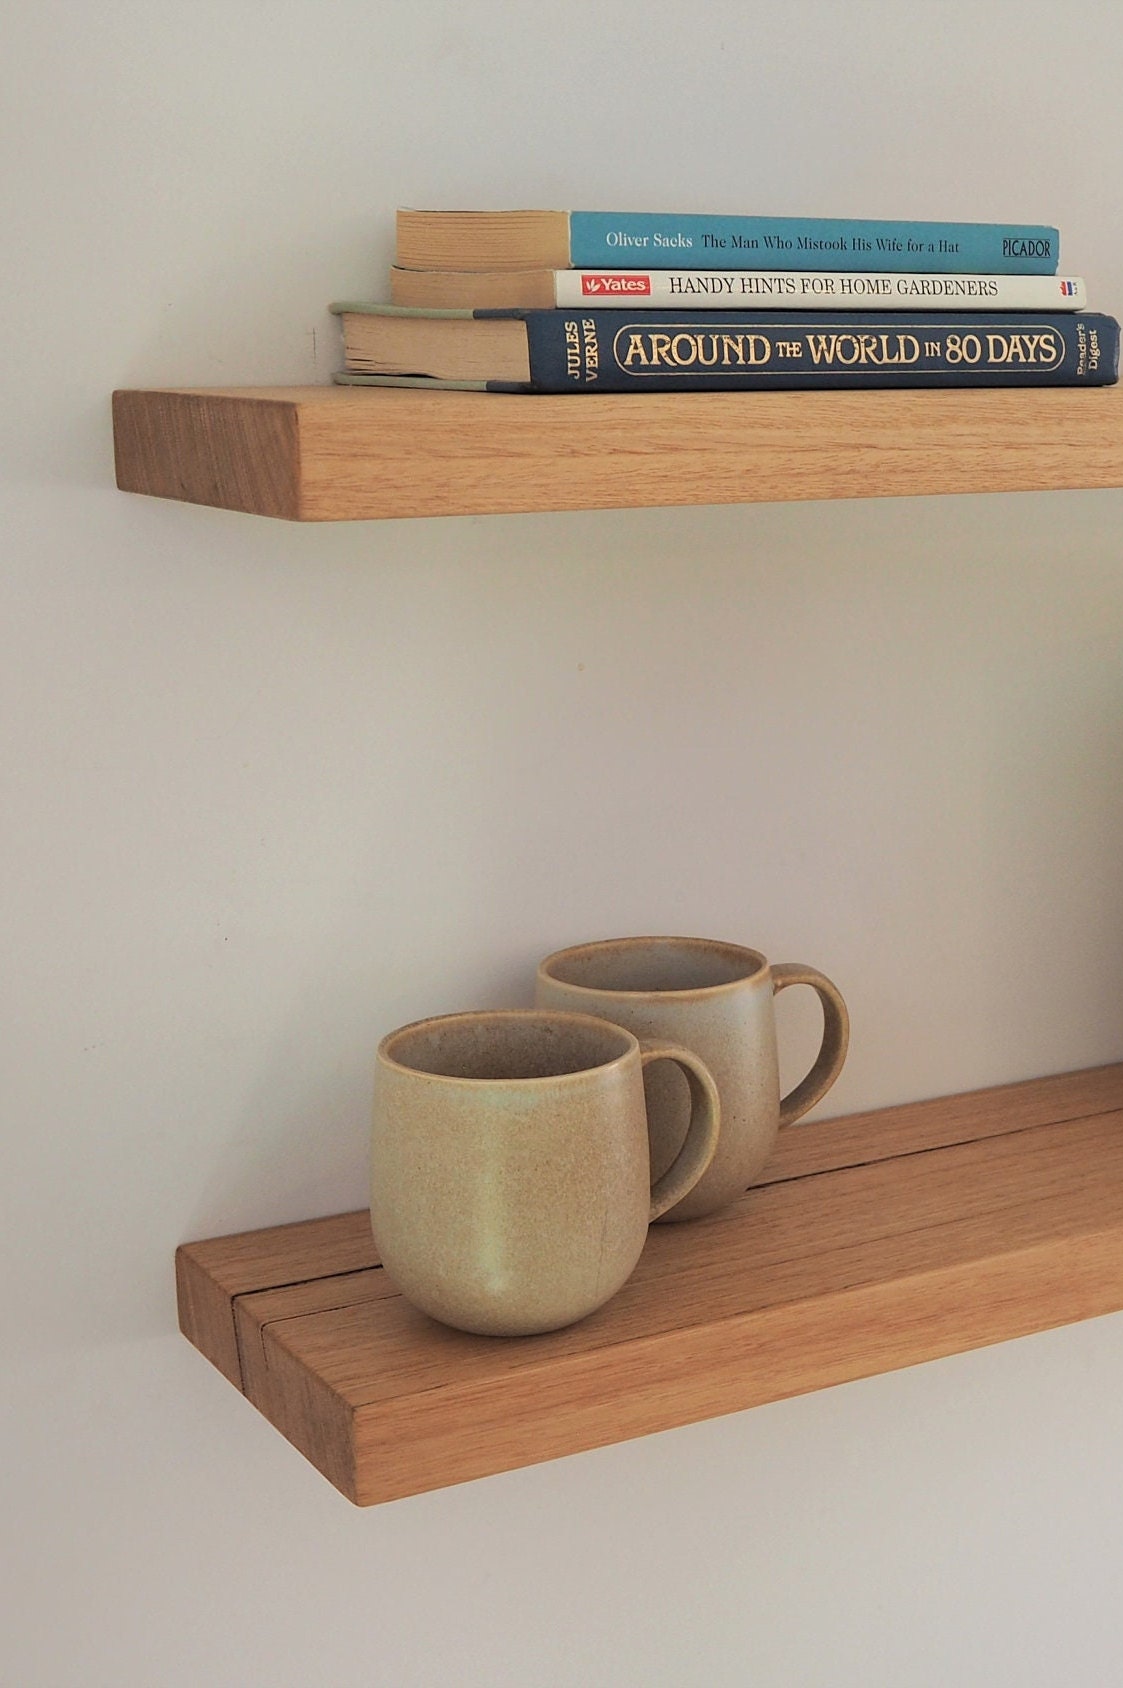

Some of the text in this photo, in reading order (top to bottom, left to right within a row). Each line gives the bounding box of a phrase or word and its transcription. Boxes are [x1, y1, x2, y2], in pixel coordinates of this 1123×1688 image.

[605, 232, 959, 253] Oliver Sacks The Man Who Mistook His Wife for a Hat
[1002, 240, 1051, 257] PICADOR
[600, 278, 647, 293] Yates
[669, 277, 998, 296] HANDY HINTS FOR HOME GARDENERS
[565, 321, 580, 380] JULES
[582, 318, 599, 382] VERNE
[623, 333, 1057, 366] AROUND THE WORLD IN 80 DAYS
[1089, 329, 1100, 371] Digest
